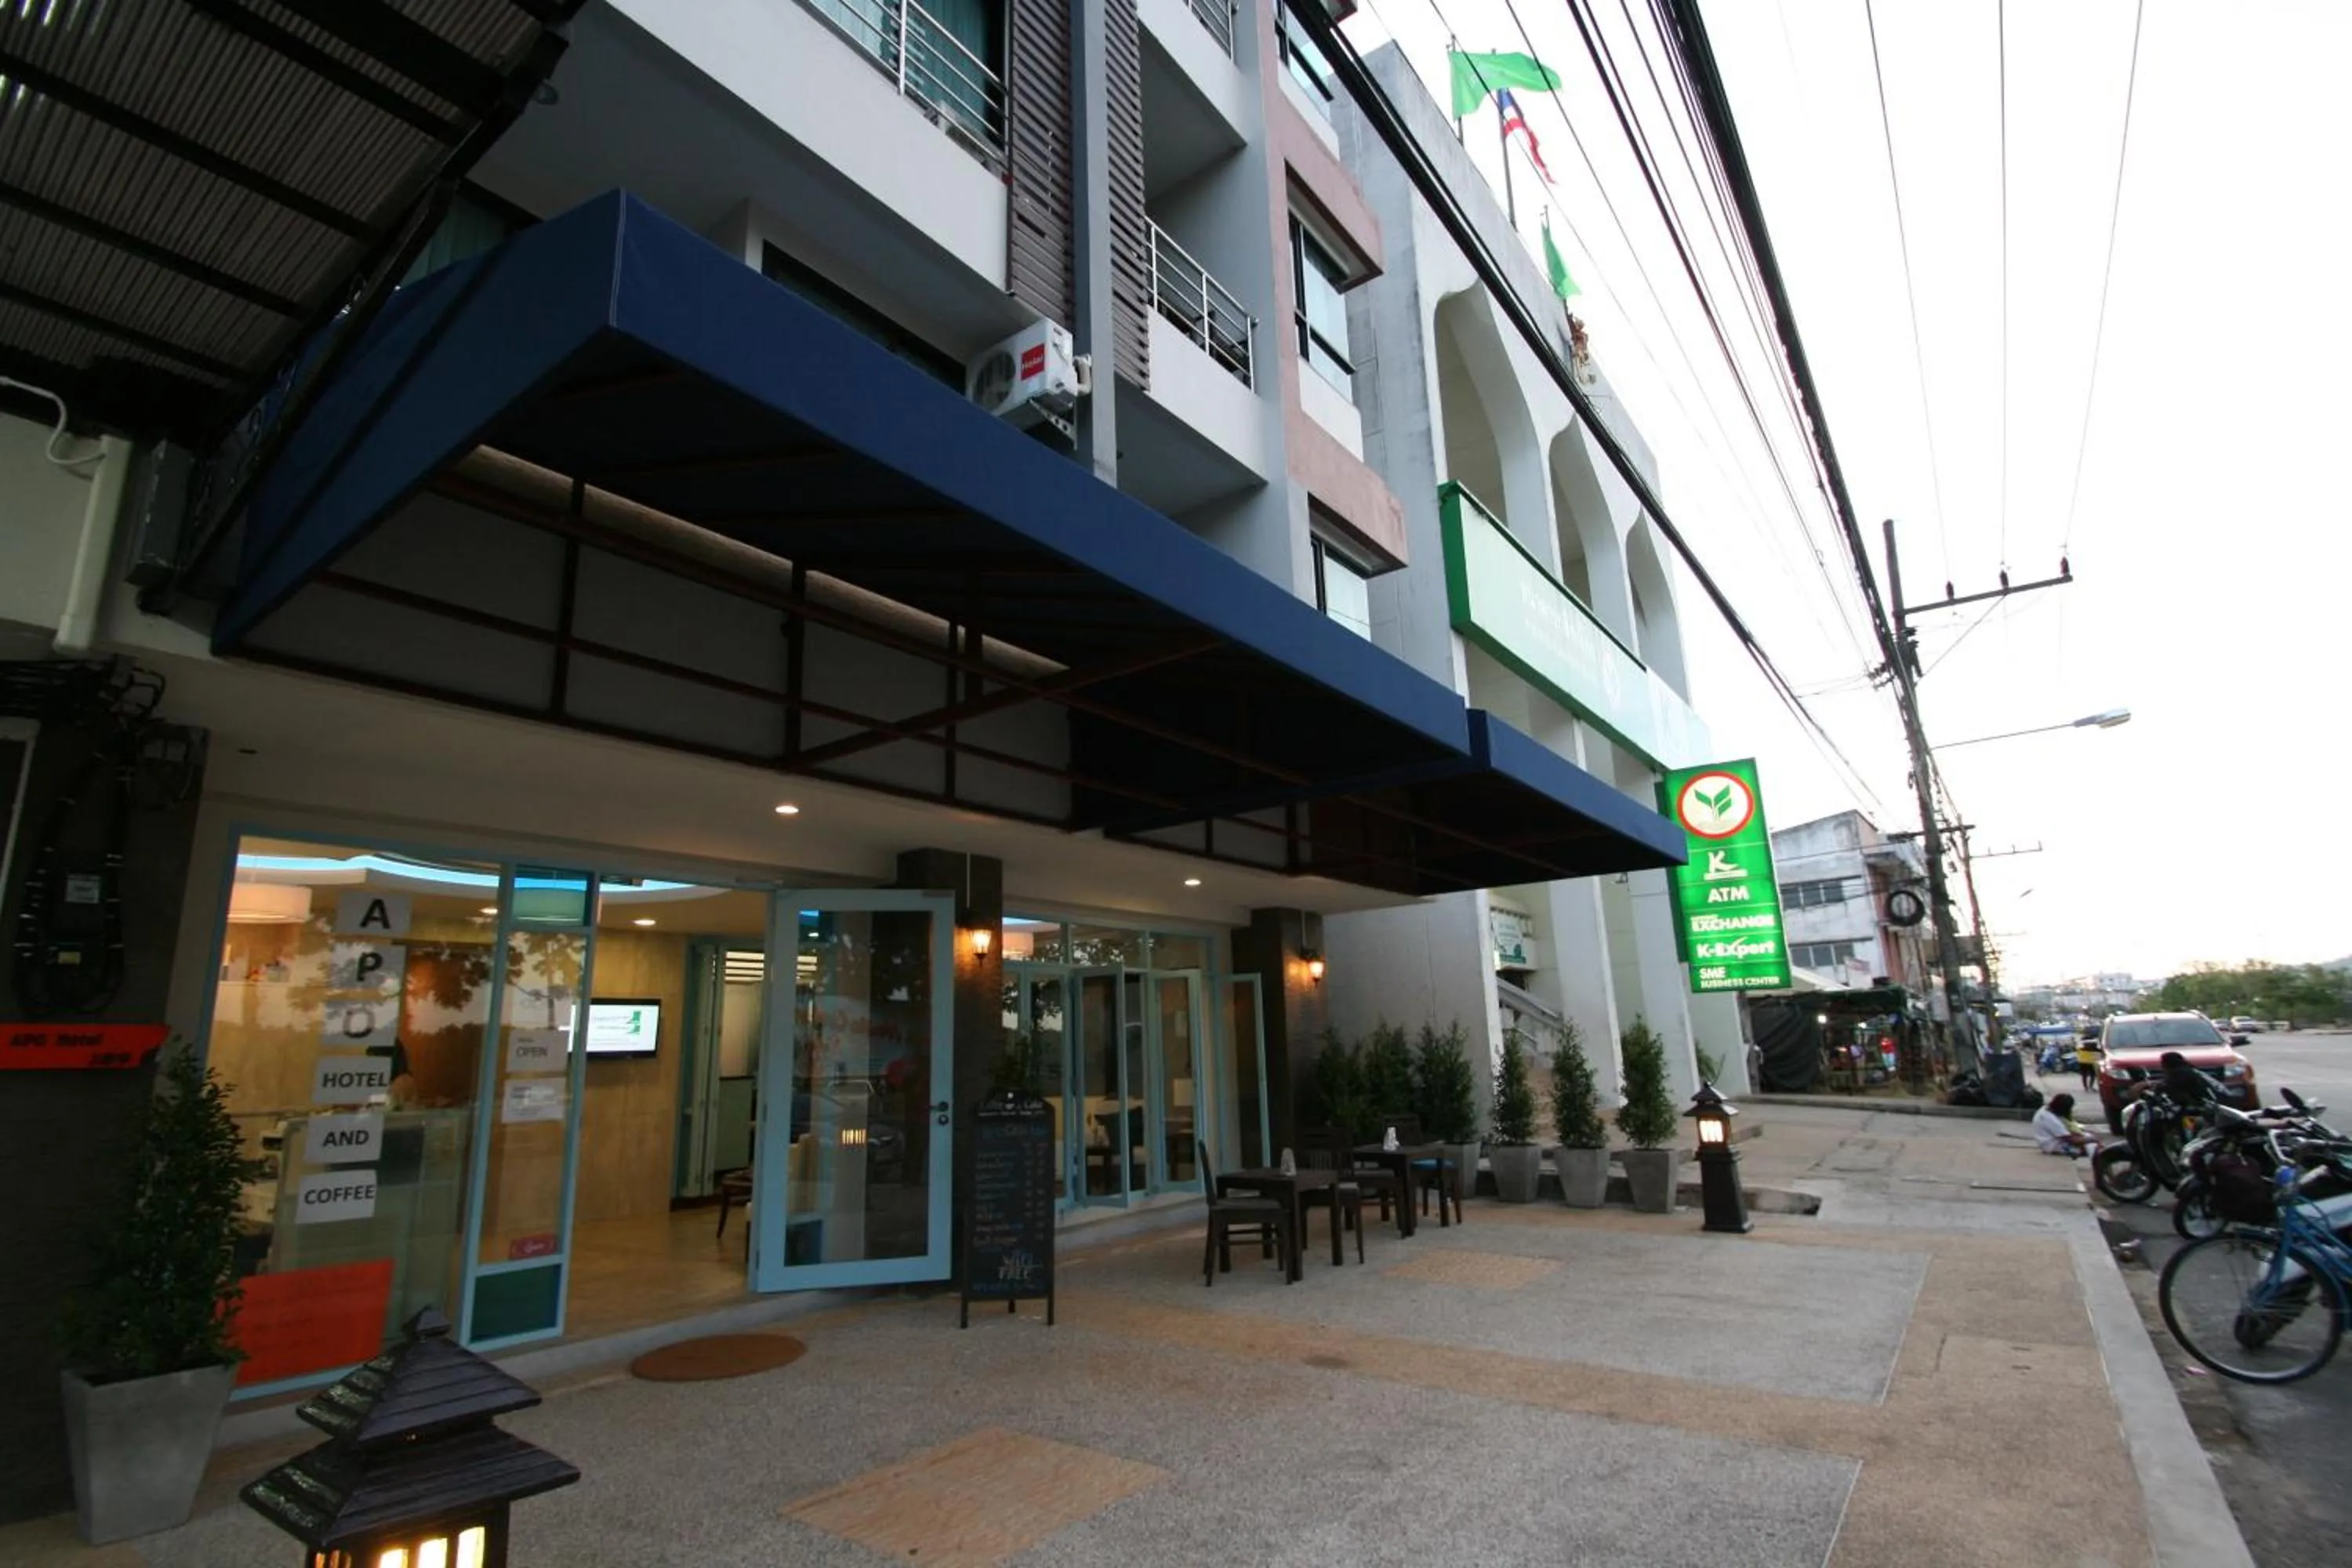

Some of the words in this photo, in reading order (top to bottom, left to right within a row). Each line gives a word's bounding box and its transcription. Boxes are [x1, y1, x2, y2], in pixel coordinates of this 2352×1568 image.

[1708, 885, 1750, 903] ATM
[359, 898, 390, 929] A
[357, 951, 384, 982] P
[1700, 966, 1726, 979] SME
[1744, 976, 1780, 985] CENTER
[343, 1007, 376, 1039] O
[516, 1045, 548, 1058] OPEN
[321, 1071, 388, 1088] HOTEL
[322, 1129, 370, 1148] AND
[303, 1184, 376, 1205] COFFEE
